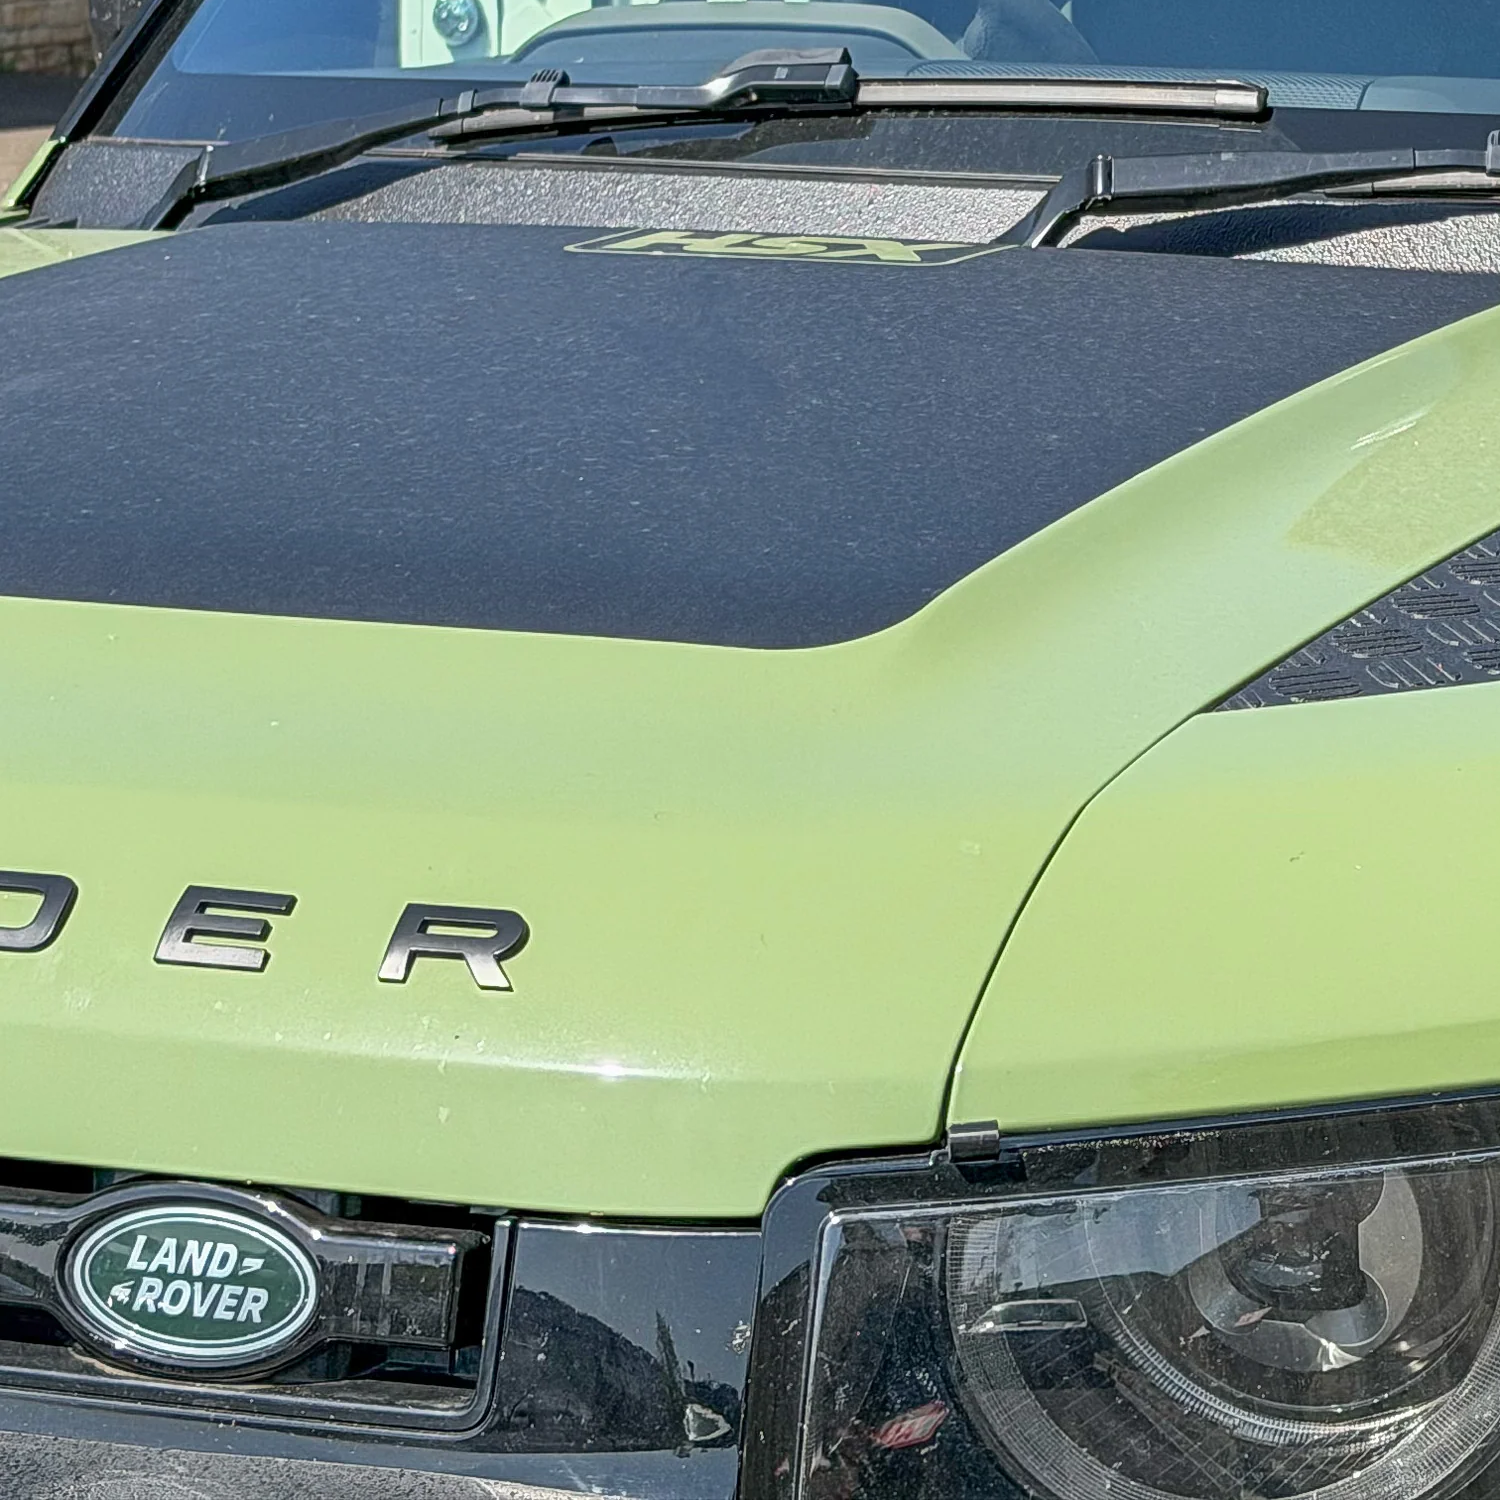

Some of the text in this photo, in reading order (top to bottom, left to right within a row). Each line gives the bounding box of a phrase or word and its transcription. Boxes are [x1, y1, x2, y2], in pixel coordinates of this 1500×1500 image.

[601, 231, 974, 262] HSX
[126, 1234, 239, 1277] LAND
[132, 1278, 269, 1323] ROVER
